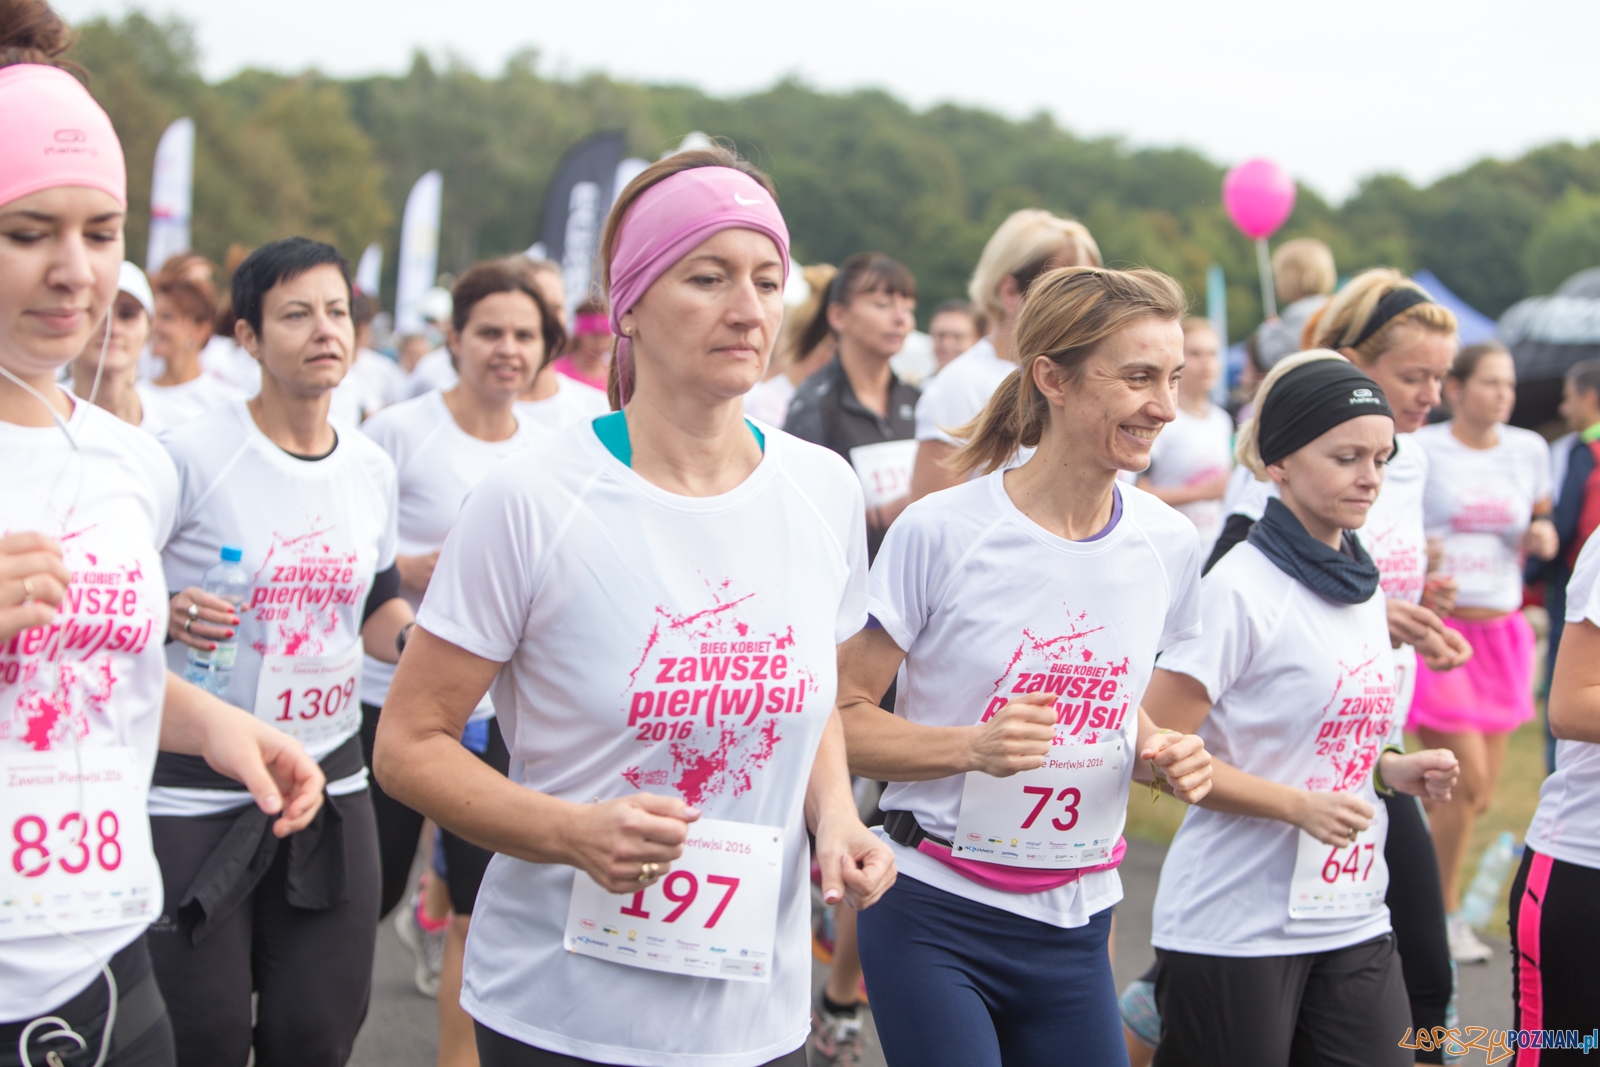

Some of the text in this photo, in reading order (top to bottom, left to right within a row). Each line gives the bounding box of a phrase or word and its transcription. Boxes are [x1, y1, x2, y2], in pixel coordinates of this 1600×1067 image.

[271, 565, 353, 584] zawsze
[255, 607, 289, 622] 2016
[700, 641, 771, 654] BIEG KOBIET
[655, 655, 788, 684] zawsze
[1050, 663, 1108, 678] BIEG KOBIET
[275, 676, 355, 722] 1309
[1011, 672, 1118, 702] zawsze
[626, 679, 806, 727] pier(w)si!
[636, 721, 694, 741] 2016
[1049, 759, 1086, 770] Pier(w)si
[1086, 757, 1104, 768] 2016
[1020, 785, 1082, 832] 73
[12, 810, 122, 878] 838
[683, 836, 752, 855] ier(w)si 2016
[1321, 842, 1376, 884] 647
[619, 869, 741, 929] 197
